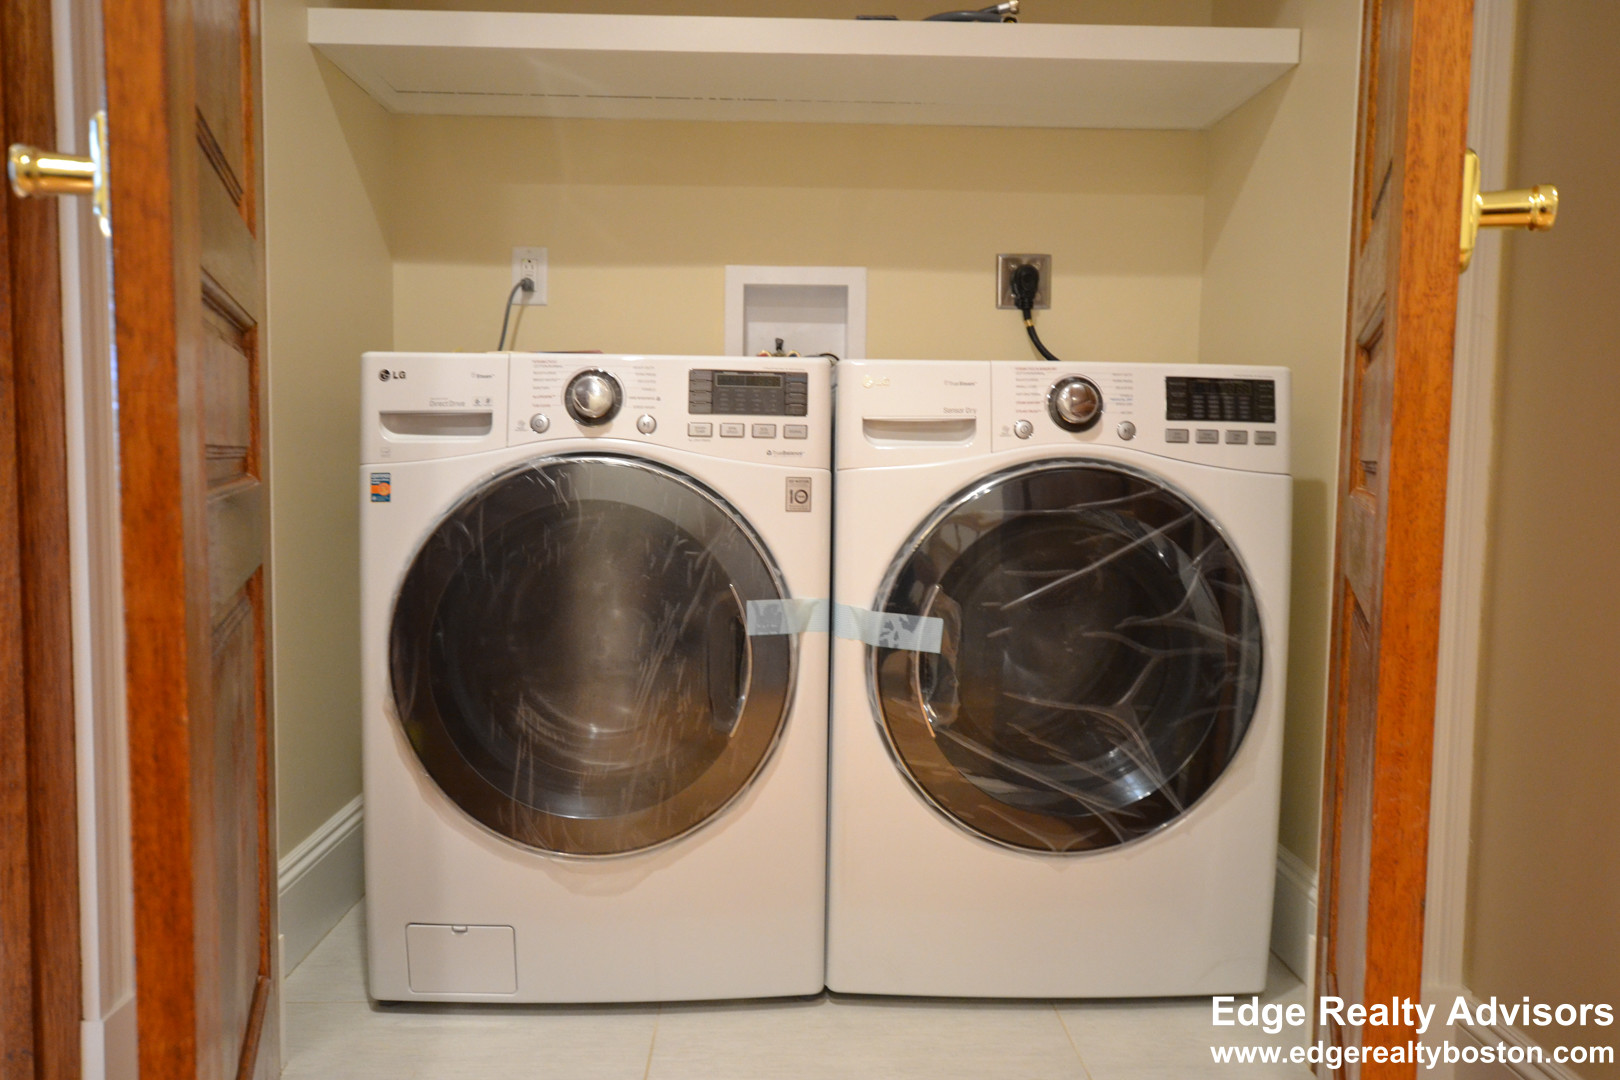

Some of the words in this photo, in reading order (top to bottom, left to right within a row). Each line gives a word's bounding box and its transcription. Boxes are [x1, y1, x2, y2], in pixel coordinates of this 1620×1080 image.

[392, 370, 407, 380] LG
[943, 407, 964, 415] Sensor
[965, 407, 978, 416] Dry
